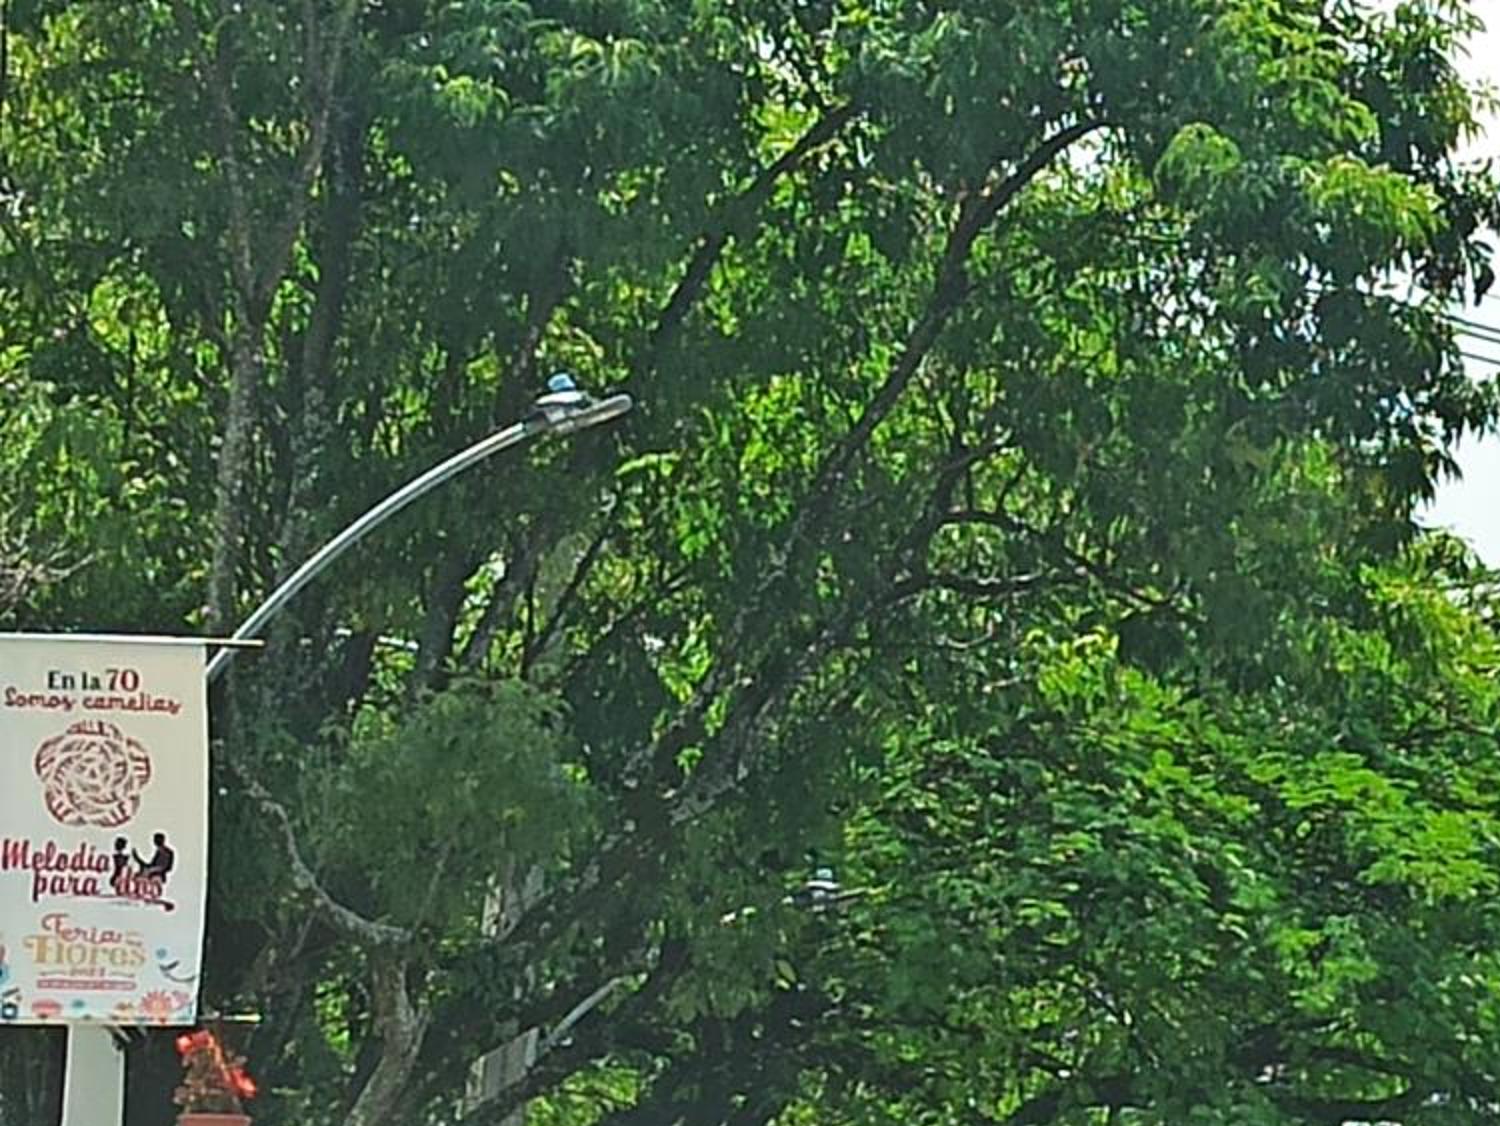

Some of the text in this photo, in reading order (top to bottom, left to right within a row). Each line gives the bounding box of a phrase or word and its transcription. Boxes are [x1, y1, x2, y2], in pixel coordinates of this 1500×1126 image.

[48, 668, 139, 692] En la 70
[5, 686, 181, 714] Somos camelias
[33, 874, 100, 902] para
[42, 912, 122, 944] Feria
